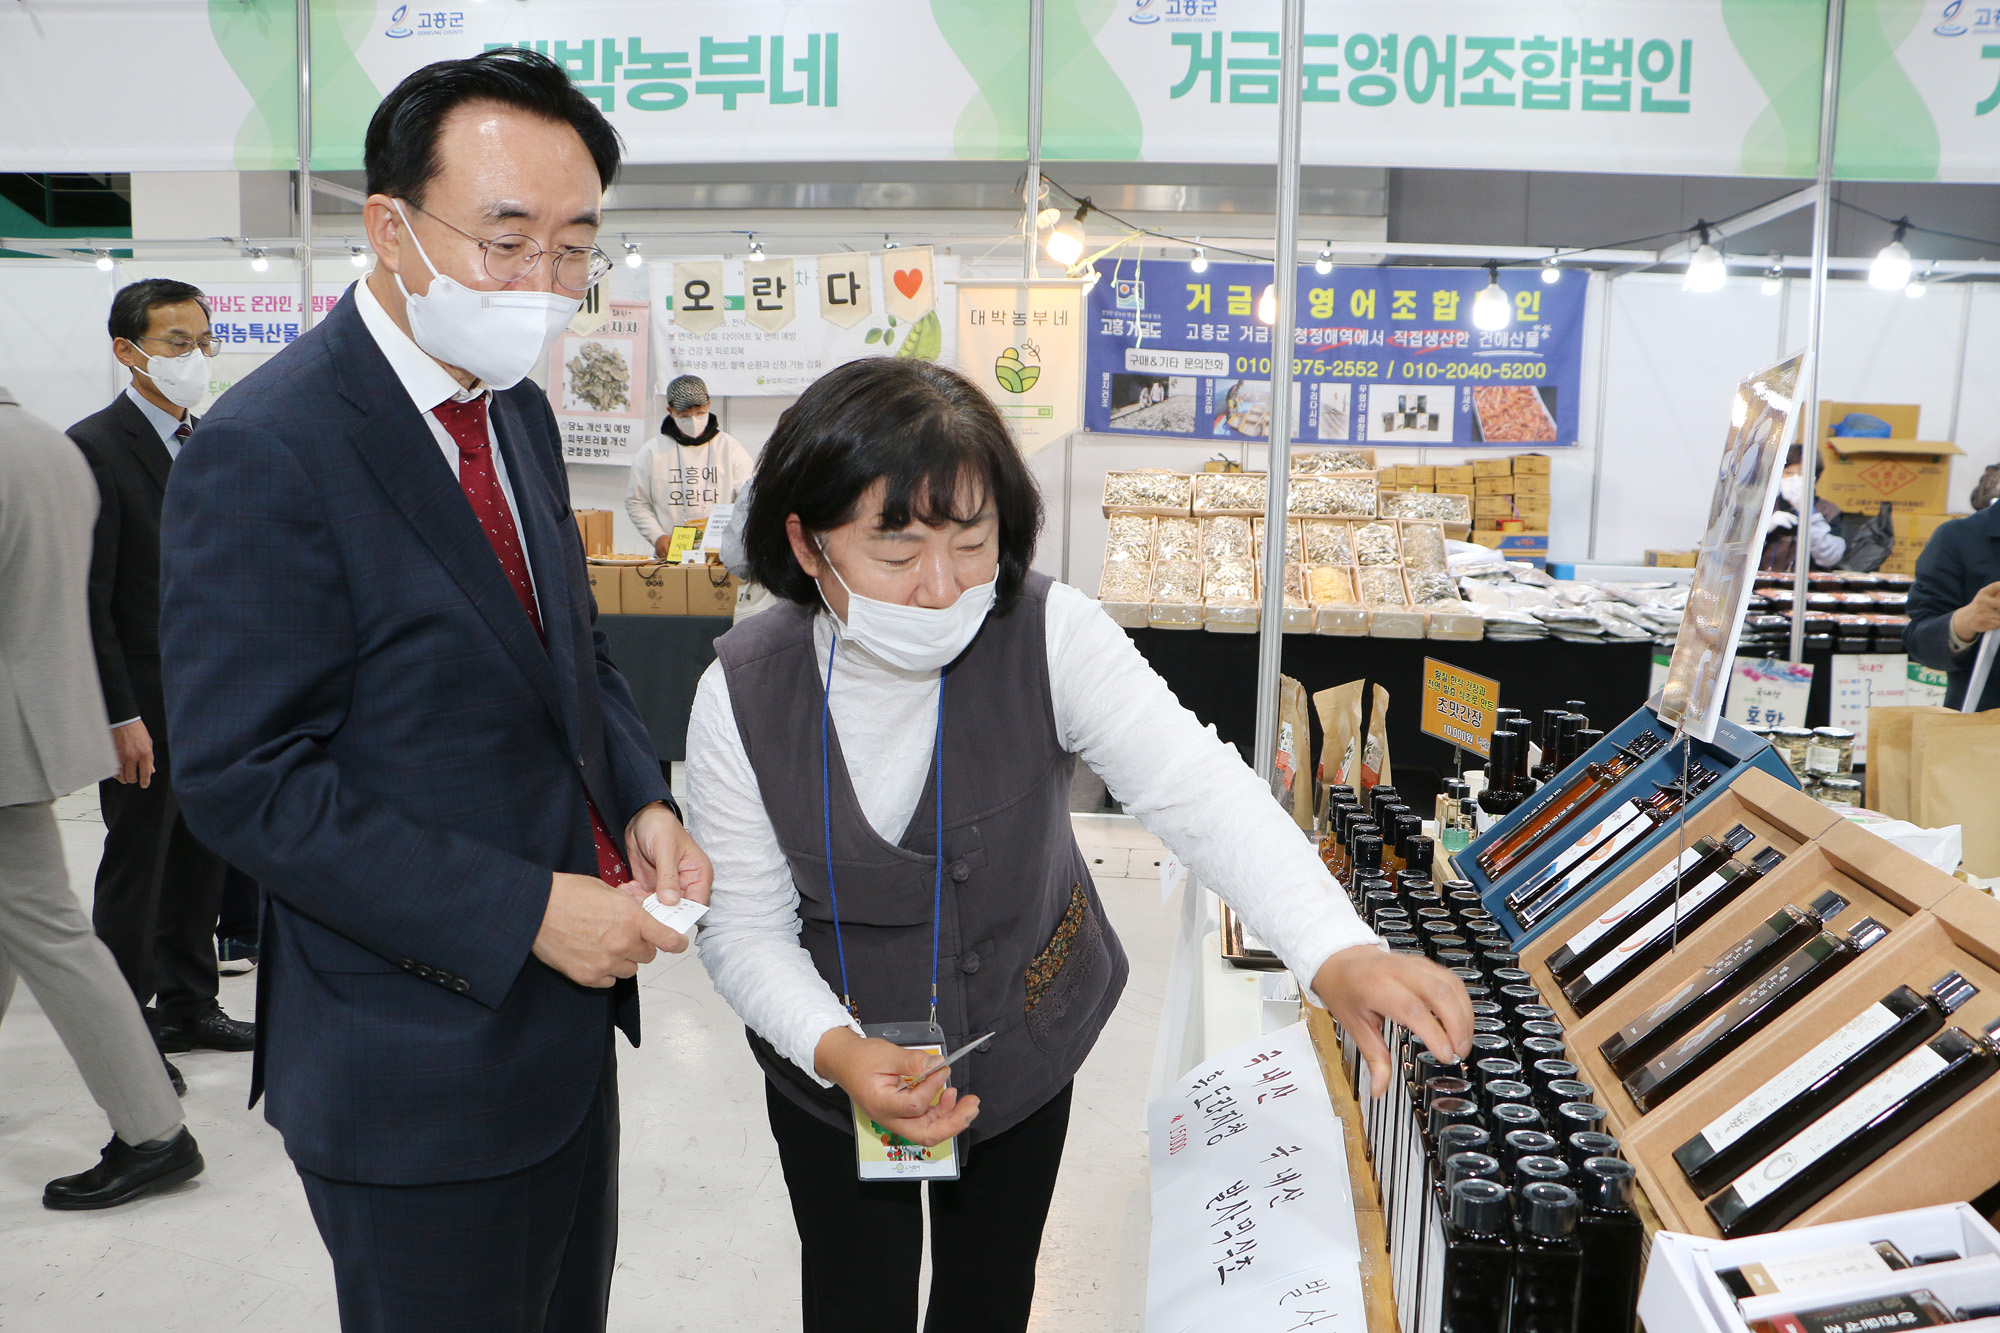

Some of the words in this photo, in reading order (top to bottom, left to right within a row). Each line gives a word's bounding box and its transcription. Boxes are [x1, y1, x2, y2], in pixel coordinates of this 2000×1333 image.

[1165, 0, 1217, 16] 고흥군
[417, 11, 464, 30] 고흥군
[417, 29, 443, 37] GOHEUNG
[443, 28, 464, 36] COUNTY
[484, 33, 839, 112] 박농부네
[1169, 31, 1694, 114] 거금도영어조합법인
[203, 295, 247, 312] 라남도
[251, 295, 292, 313] 온라인
[297, 296, 338, 312] 핑몰
[1186, 283, 1541, 322] 거금영어조합인
[970, 309, 1069, 327] 대박농부네
[1101, 318, 1124, 336] 고흥
[1126, 320, 1162, 338] 거금도
[209, 322, 299, 344] 역농특산물
[722, 332, 752, 341] 다이어트
[754, 333, 762, 341] 및
[781, 332, 797, 341] 예방
[1186, 323, 1230, 342] 고흥군
[1239, 325, 1273, 343] 거금
[1294, 327, 1384, 346] 청정해역에서
[1393, 330, 1470, 348] 직접생산한
[1479, 331, 1540, 349] 건해산물
[688, 347, 703, 356] 건강
[705, 347, 713, 355] 및
[715, 347, 745, 355] 피로회복
[806, 360, 822, 369] 강화
[1129, 354, 1180, 369] 구매&기타
[1184, 356, 1225, 371] 문의전화
[1236, 356, 1378, 378] 010975-2552
[1402, 362, 1547, 380] 010-2040-5200
[1309, 383, 1318, 428] 뿌리다시마
[568, 421, 585, 432] 당뇨
[586, 421, 602, 433] 개선
[604, 423, 612, 433] 및
[613, 423, 631, 434] 예방
[567, 434, 608, 446] 피부트러블
[610, 435, 627, 447] 개선
[668, 465, 718, 485] 고흥에
[668, 487, 720, 507] 오란다
[1450, 675, 1464, 689] 한식
[1465, 680, 1486, 697] 간장과
[1443, 684, 1457, 697] 발효
[1458, 690, 1478, 706] 식초로
[1480, 697, 1494, 712] 만든
[1436, 696, 1483, 729] 초맛간장
[1243, 1049, 1299, 1106] 국내산
[1185, 1069, 1249, 1147] 흑도라지청
[1259, 1144, 1305, 1209] 국내산
[1205, 1179, 1258, 1287] 발사믹식초
